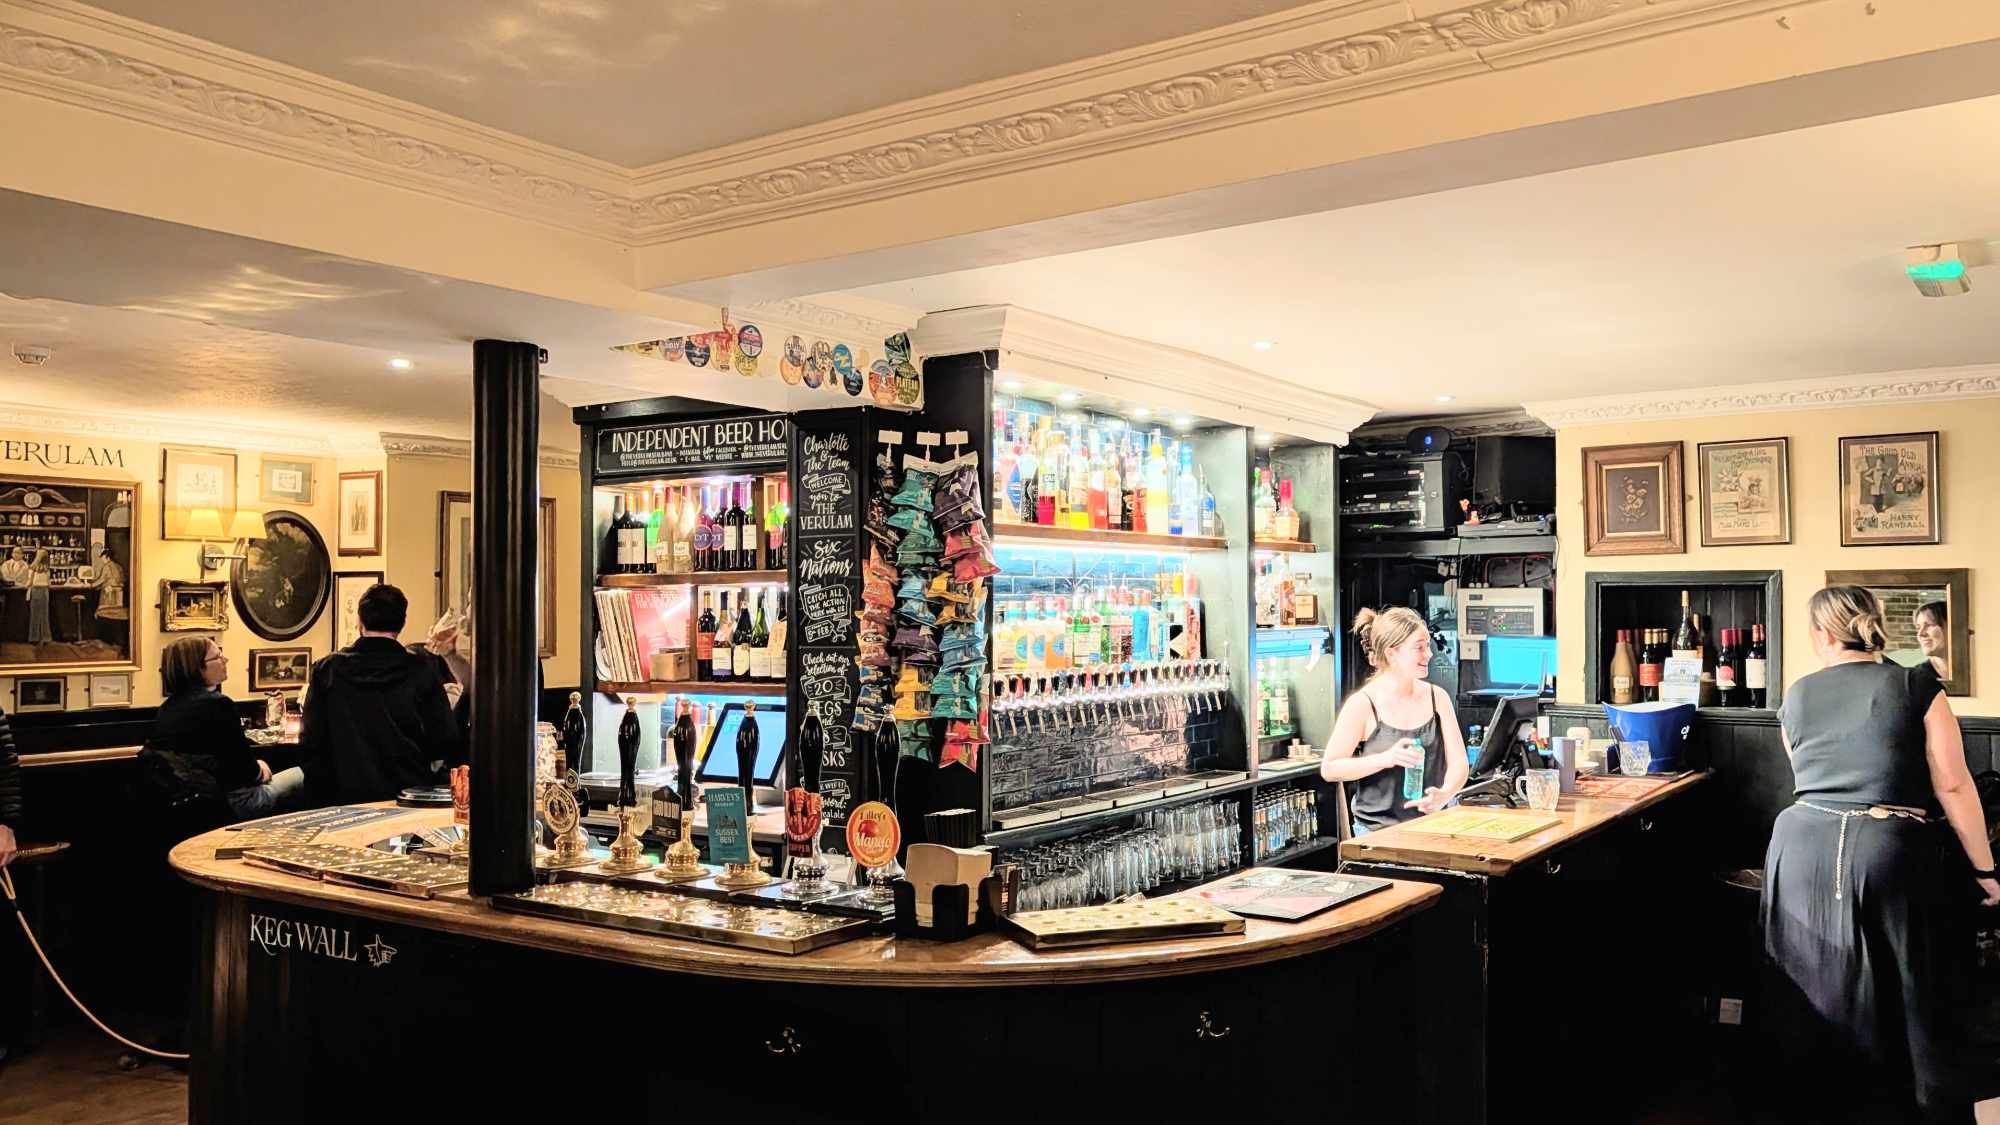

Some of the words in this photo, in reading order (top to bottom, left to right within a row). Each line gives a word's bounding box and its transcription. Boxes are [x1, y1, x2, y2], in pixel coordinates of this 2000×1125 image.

[612, 424, 711, 453] INDEPENDENT
[715, 421, 754, 446] BEER
[804, 433, 850, 455] Charlotte
[0, 439, 125, 471] ERULAM
[803, 456, 824, 473] The
[827, 453, 850, 471] Team
[820, 450, 829, 461] &
[812, 477, 842, 489] WELCOME
[809, 493, 828, 510] you
[828, 489, 842, 502] to
[815, 502, 837, 515] THE
[800, 514, 854, 530] VERULAM
[814, 539, 842, 559] Six
[799, 556, 854, 580] Nations
[807, 592, 828, 604] CATCH
[830, 588, 844, 599] ALL
[822, 598, 846, 609] ACTION
[818, 625, 829, 637] FEB
[802, 652, 826, 667] Check
[825, 652, 837, 663] out
[805, 662, 837, 678] selection
[836, 664, 848, 676] of
[814, 680, 833, 696] 20
[819, 700, 842, 717] EGS
[822, 715, 835, 726] nd
[823, 750, 846, 767] SKS
[707, 792, 741, 802] HARVEY'S
[854, 832, 890, 850] Mango
[250, 913, 294, 956] KEG
[294, 922, 358, 962] WALL
